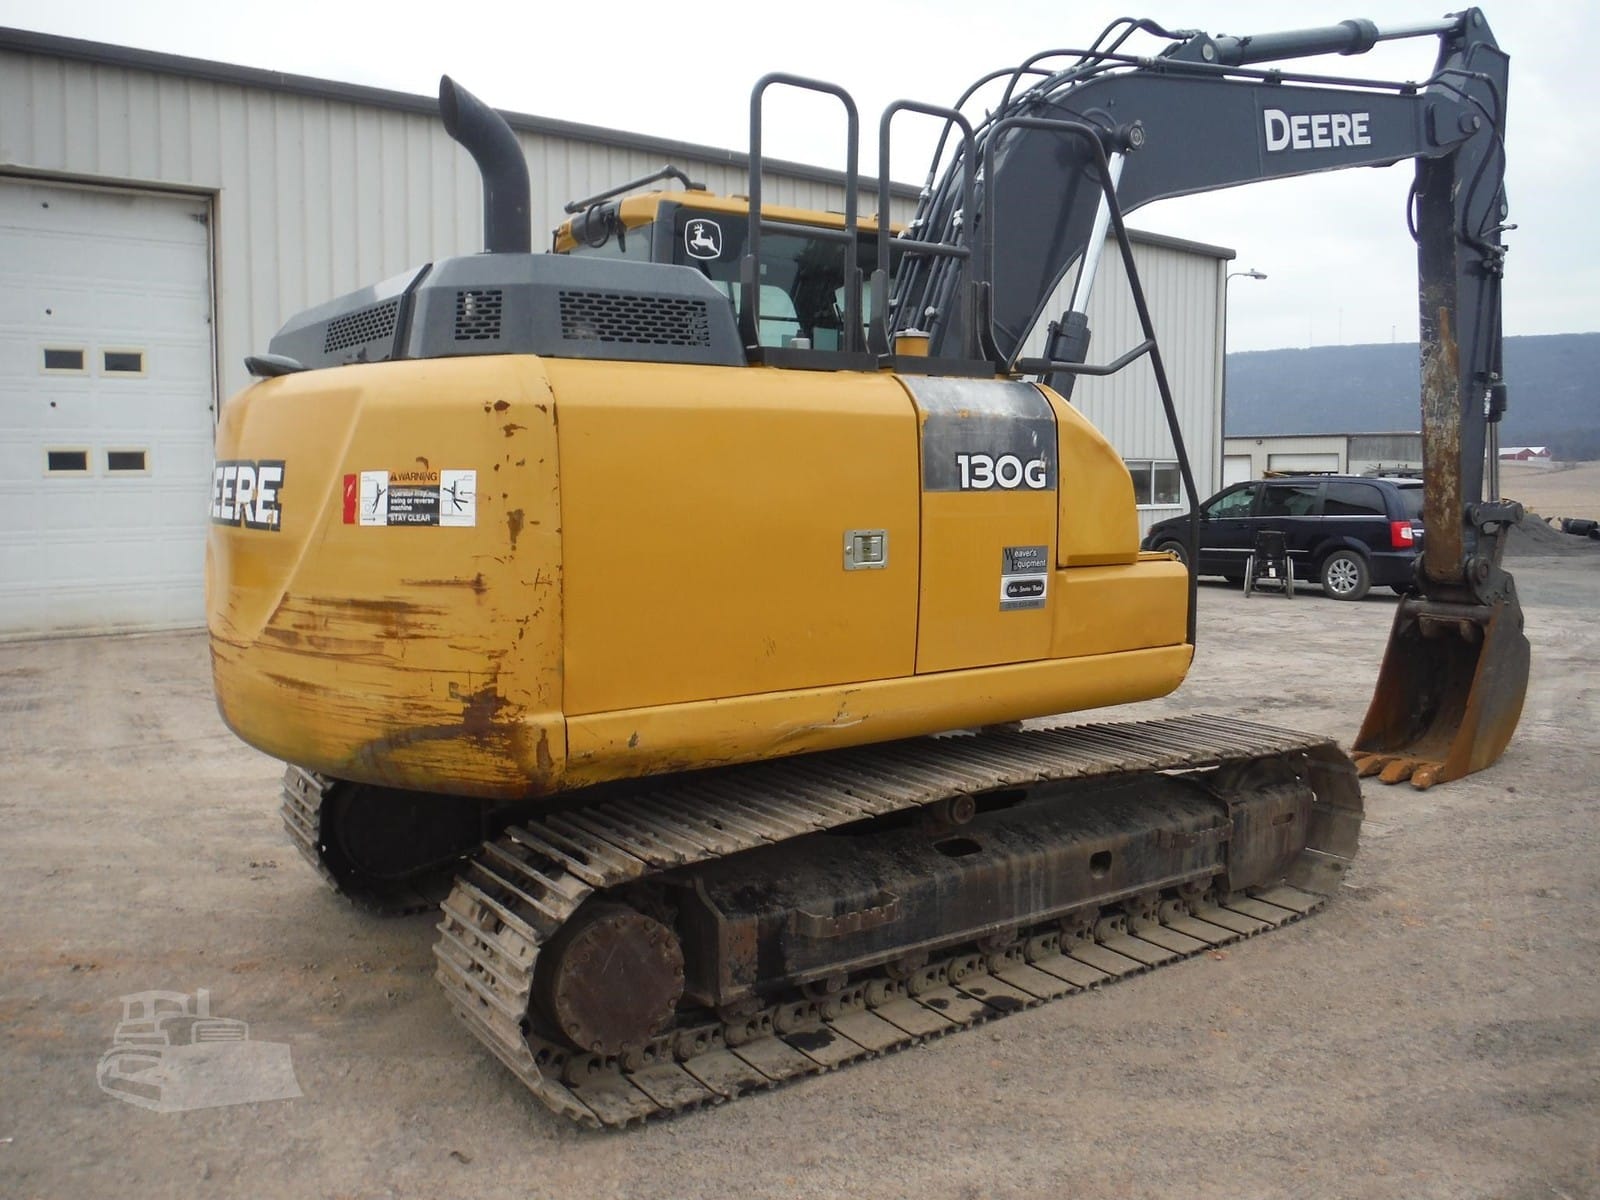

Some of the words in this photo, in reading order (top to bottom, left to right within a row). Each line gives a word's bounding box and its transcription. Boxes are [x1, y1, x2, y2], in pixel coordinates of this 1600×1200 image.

[1264, 109, 1371, 151] DEERE
[398, 471, 437, 481] WARNING
[957, 454, 1047, 489] 130G
[211, 465, 282, 524] EERE
[390, 498, 406, 506] swing
[390, 513, 406, 522] STAY
[407, 513, 431, 522] CLEAR
[1004, 548, 1037, 560] Weaver's
[1012, 558, 1046, 571] Equipment
